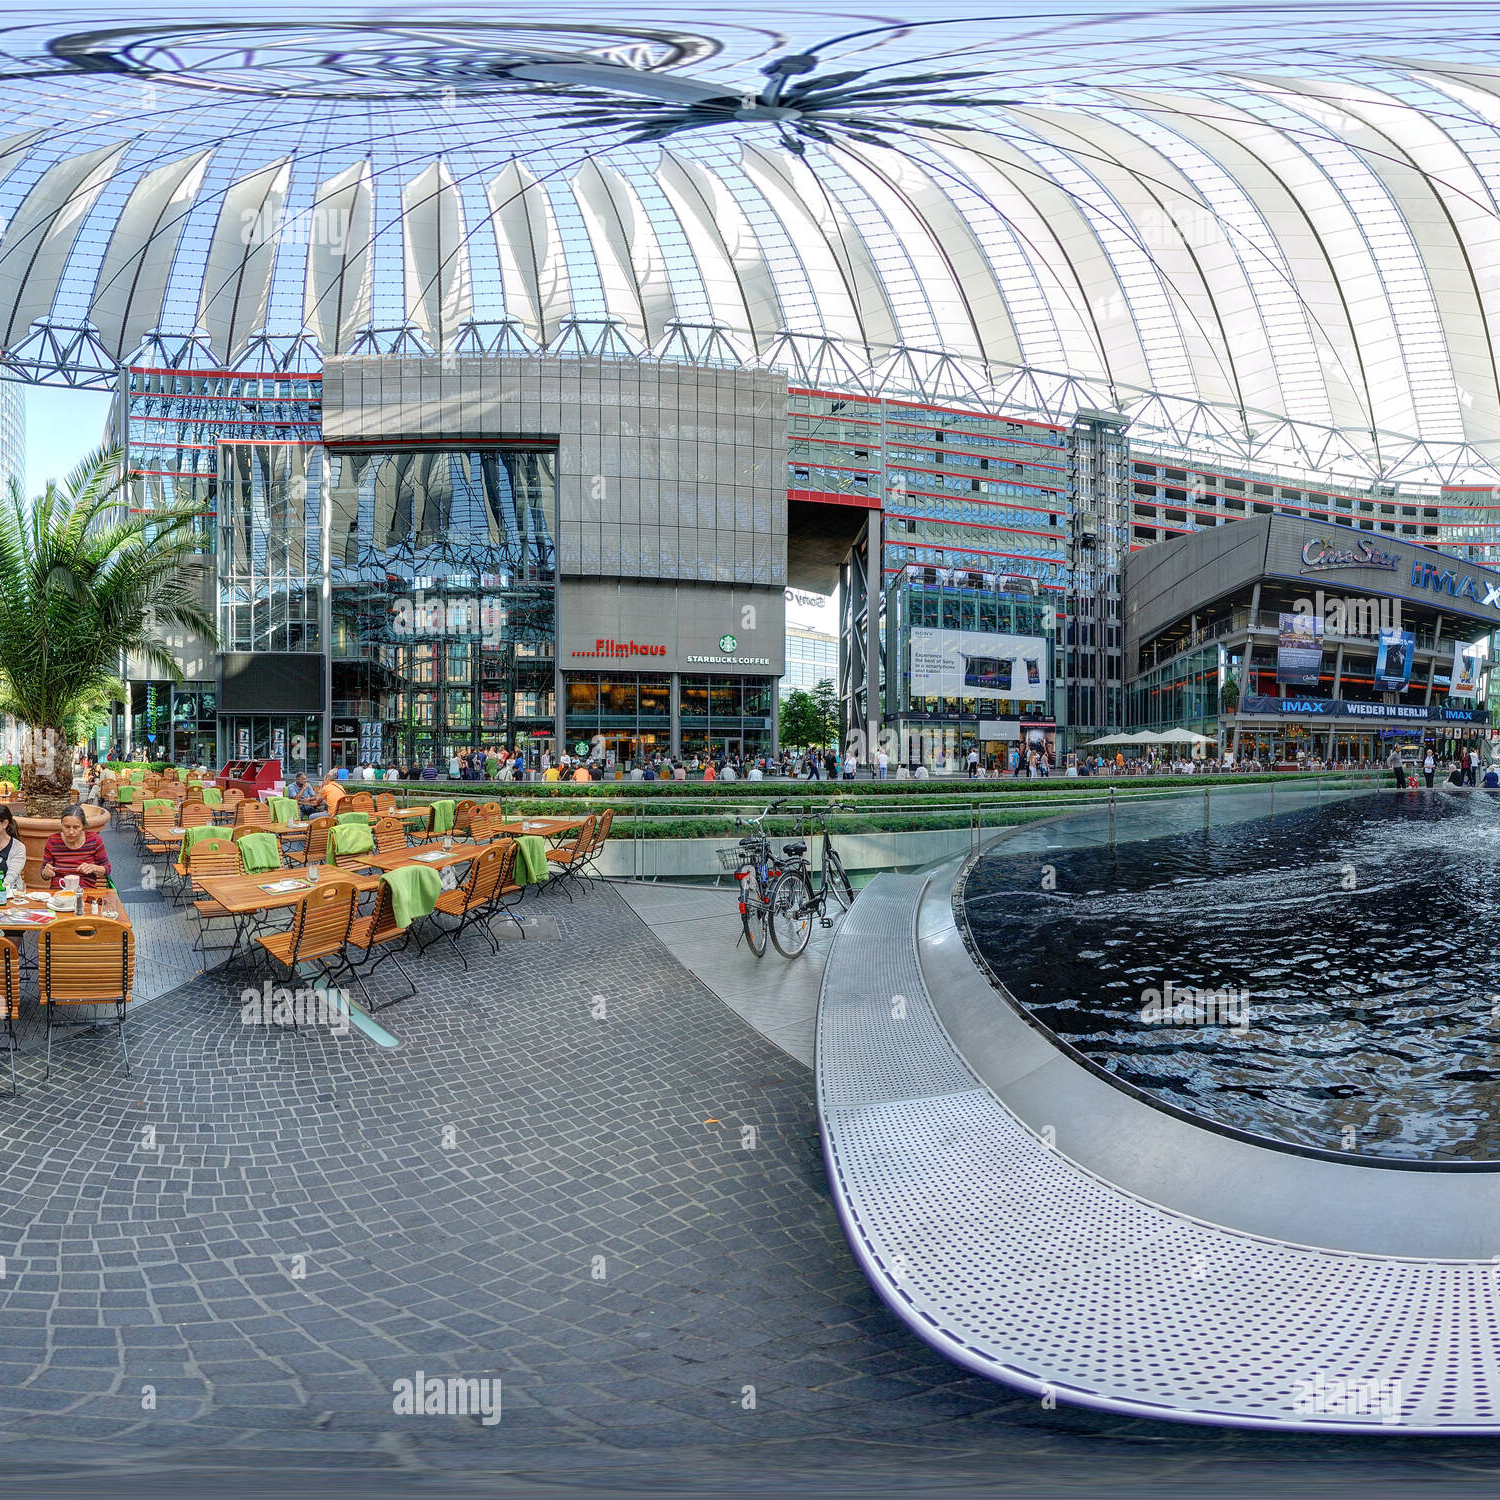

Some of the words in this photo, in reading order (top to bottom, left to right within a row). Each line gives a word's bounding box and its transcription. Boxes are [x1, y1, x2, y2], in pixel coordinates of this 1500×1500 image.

[1411, 560, 1500, 609] IMAX
[596, 639, 667, 657] Filmhaus
[687, 656, 737, 664] STARBUCKS
[738, 657, 770, 665] COFFEE
[1282, 701, 1324, 713] IMAX
[1347, 703, 1385, 716] WIEDER
[1386, 705, 1397, 717] IN
[1397, 706, 1428, 718] BERLIN
[1445, 710, 1472, 720] IMAX
